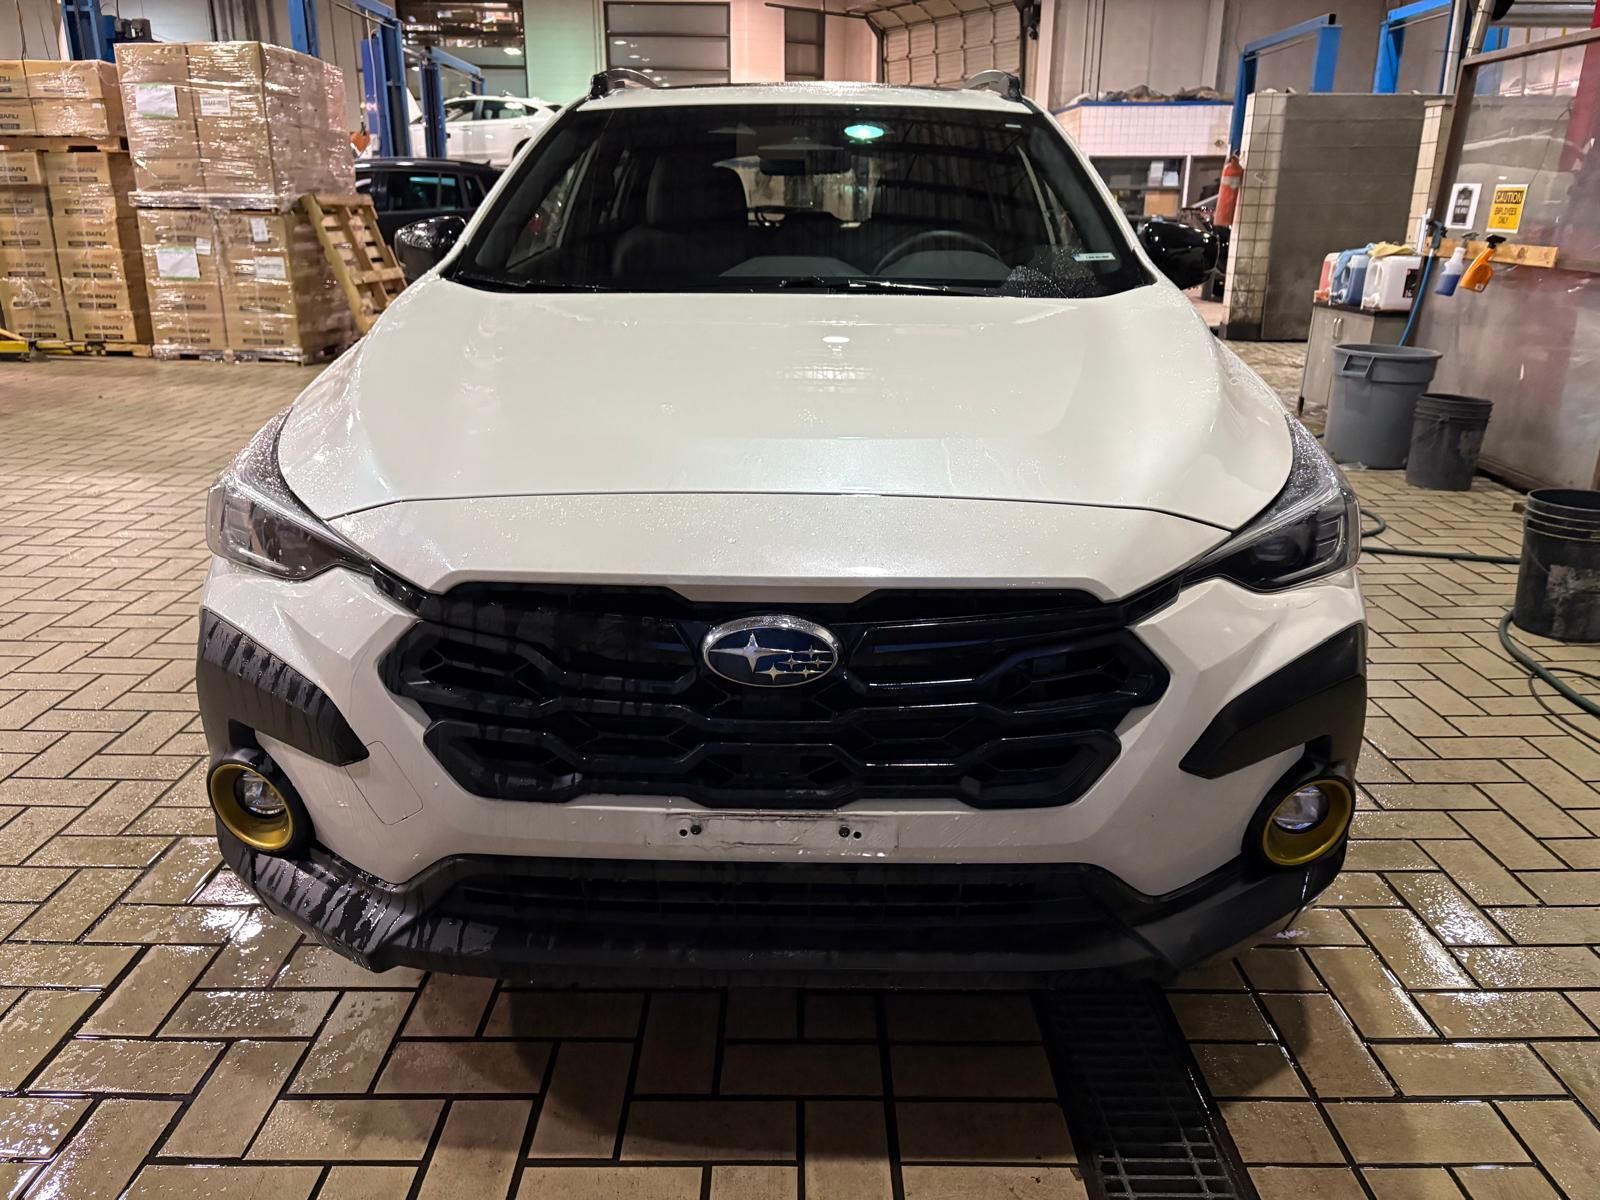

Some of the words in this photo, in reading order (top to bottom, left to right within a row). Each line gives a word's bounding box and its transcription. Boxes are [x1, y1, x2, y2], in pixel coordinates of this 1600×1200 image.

[1495, 192, 1523, 203] CAUTION
[1494, 207, 1518, 216] EMPLOYEES
[1498, 216, 1510, 224] ONLY
